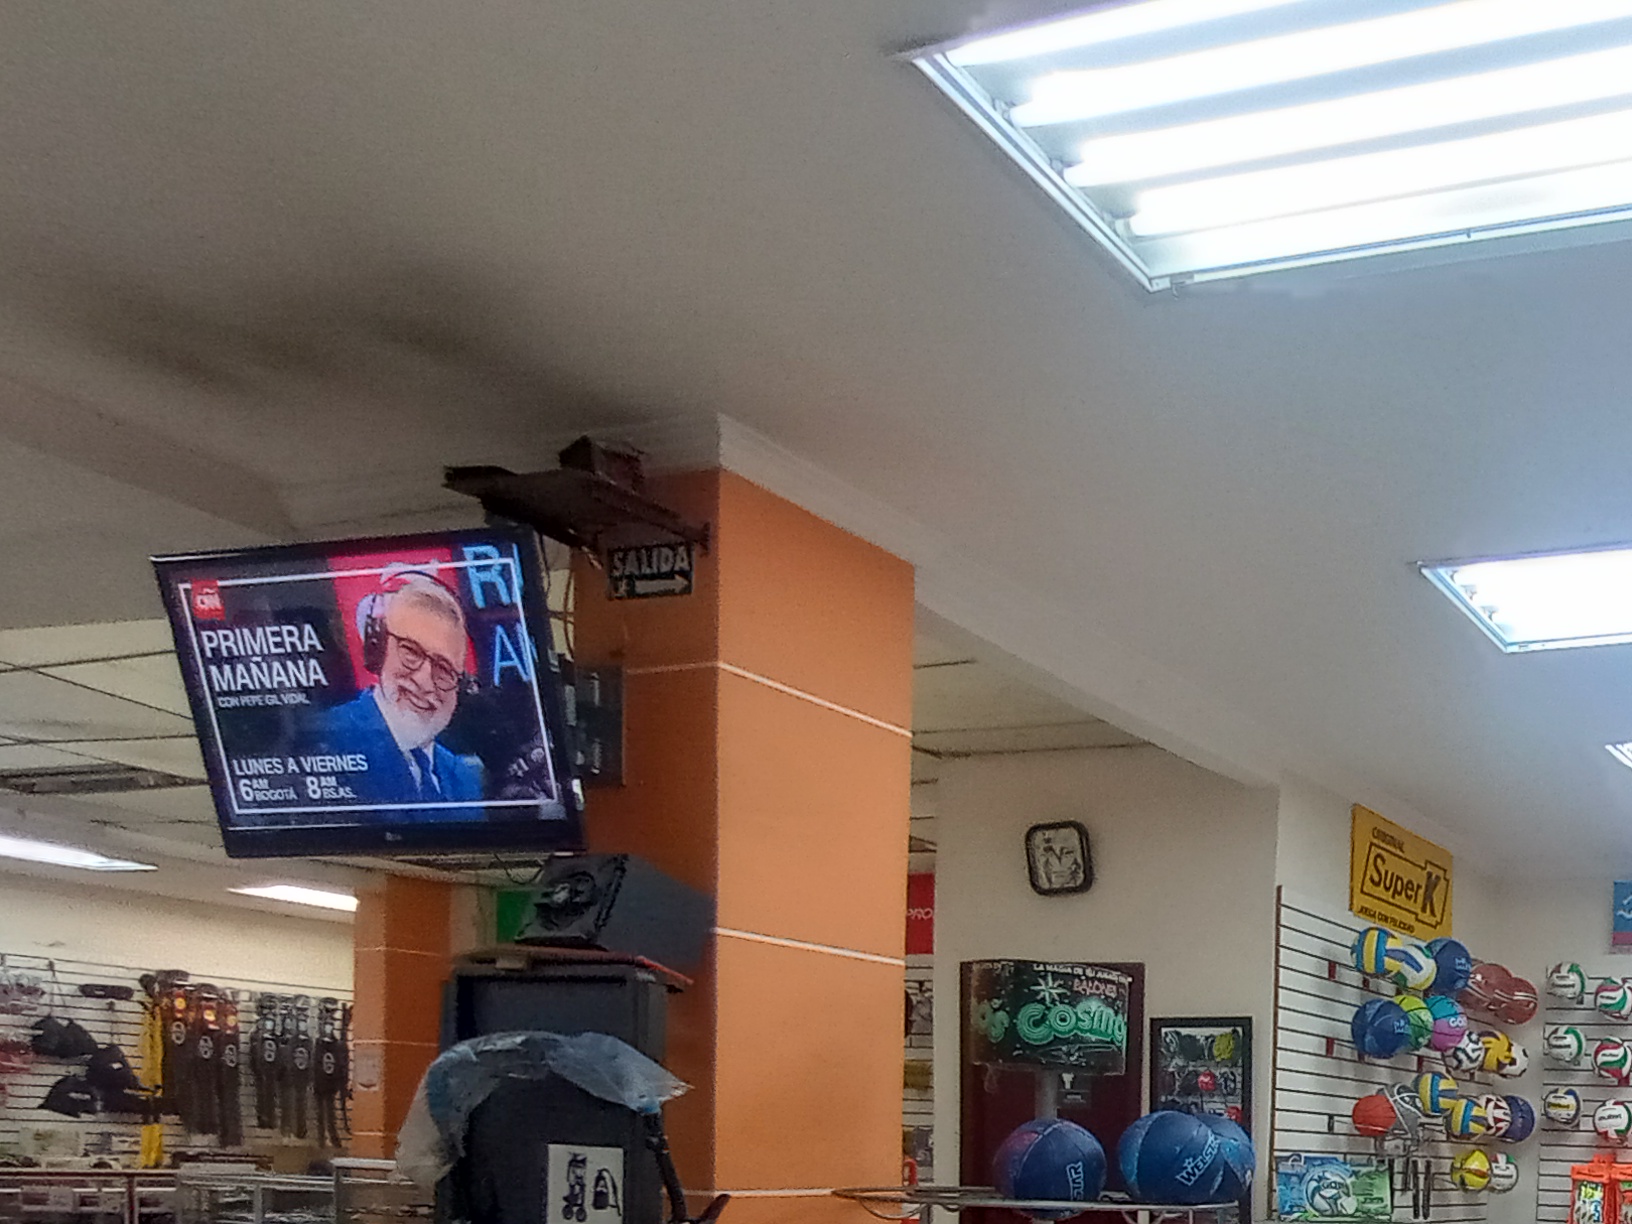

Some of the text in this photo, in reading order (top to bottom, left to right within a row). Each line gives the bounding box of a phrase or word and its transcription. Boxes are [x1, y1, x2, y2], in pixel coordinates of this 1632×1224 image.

[612, 546, 692, 576] SALIDA
[201, 624, 325, 658] PRIMERA
[209, 656, 329, 692] MAÑANA
[233, 754, 369, 775] LUNES A VIERNES
[238, 776, 337, 801] 6 AM 8 AM
